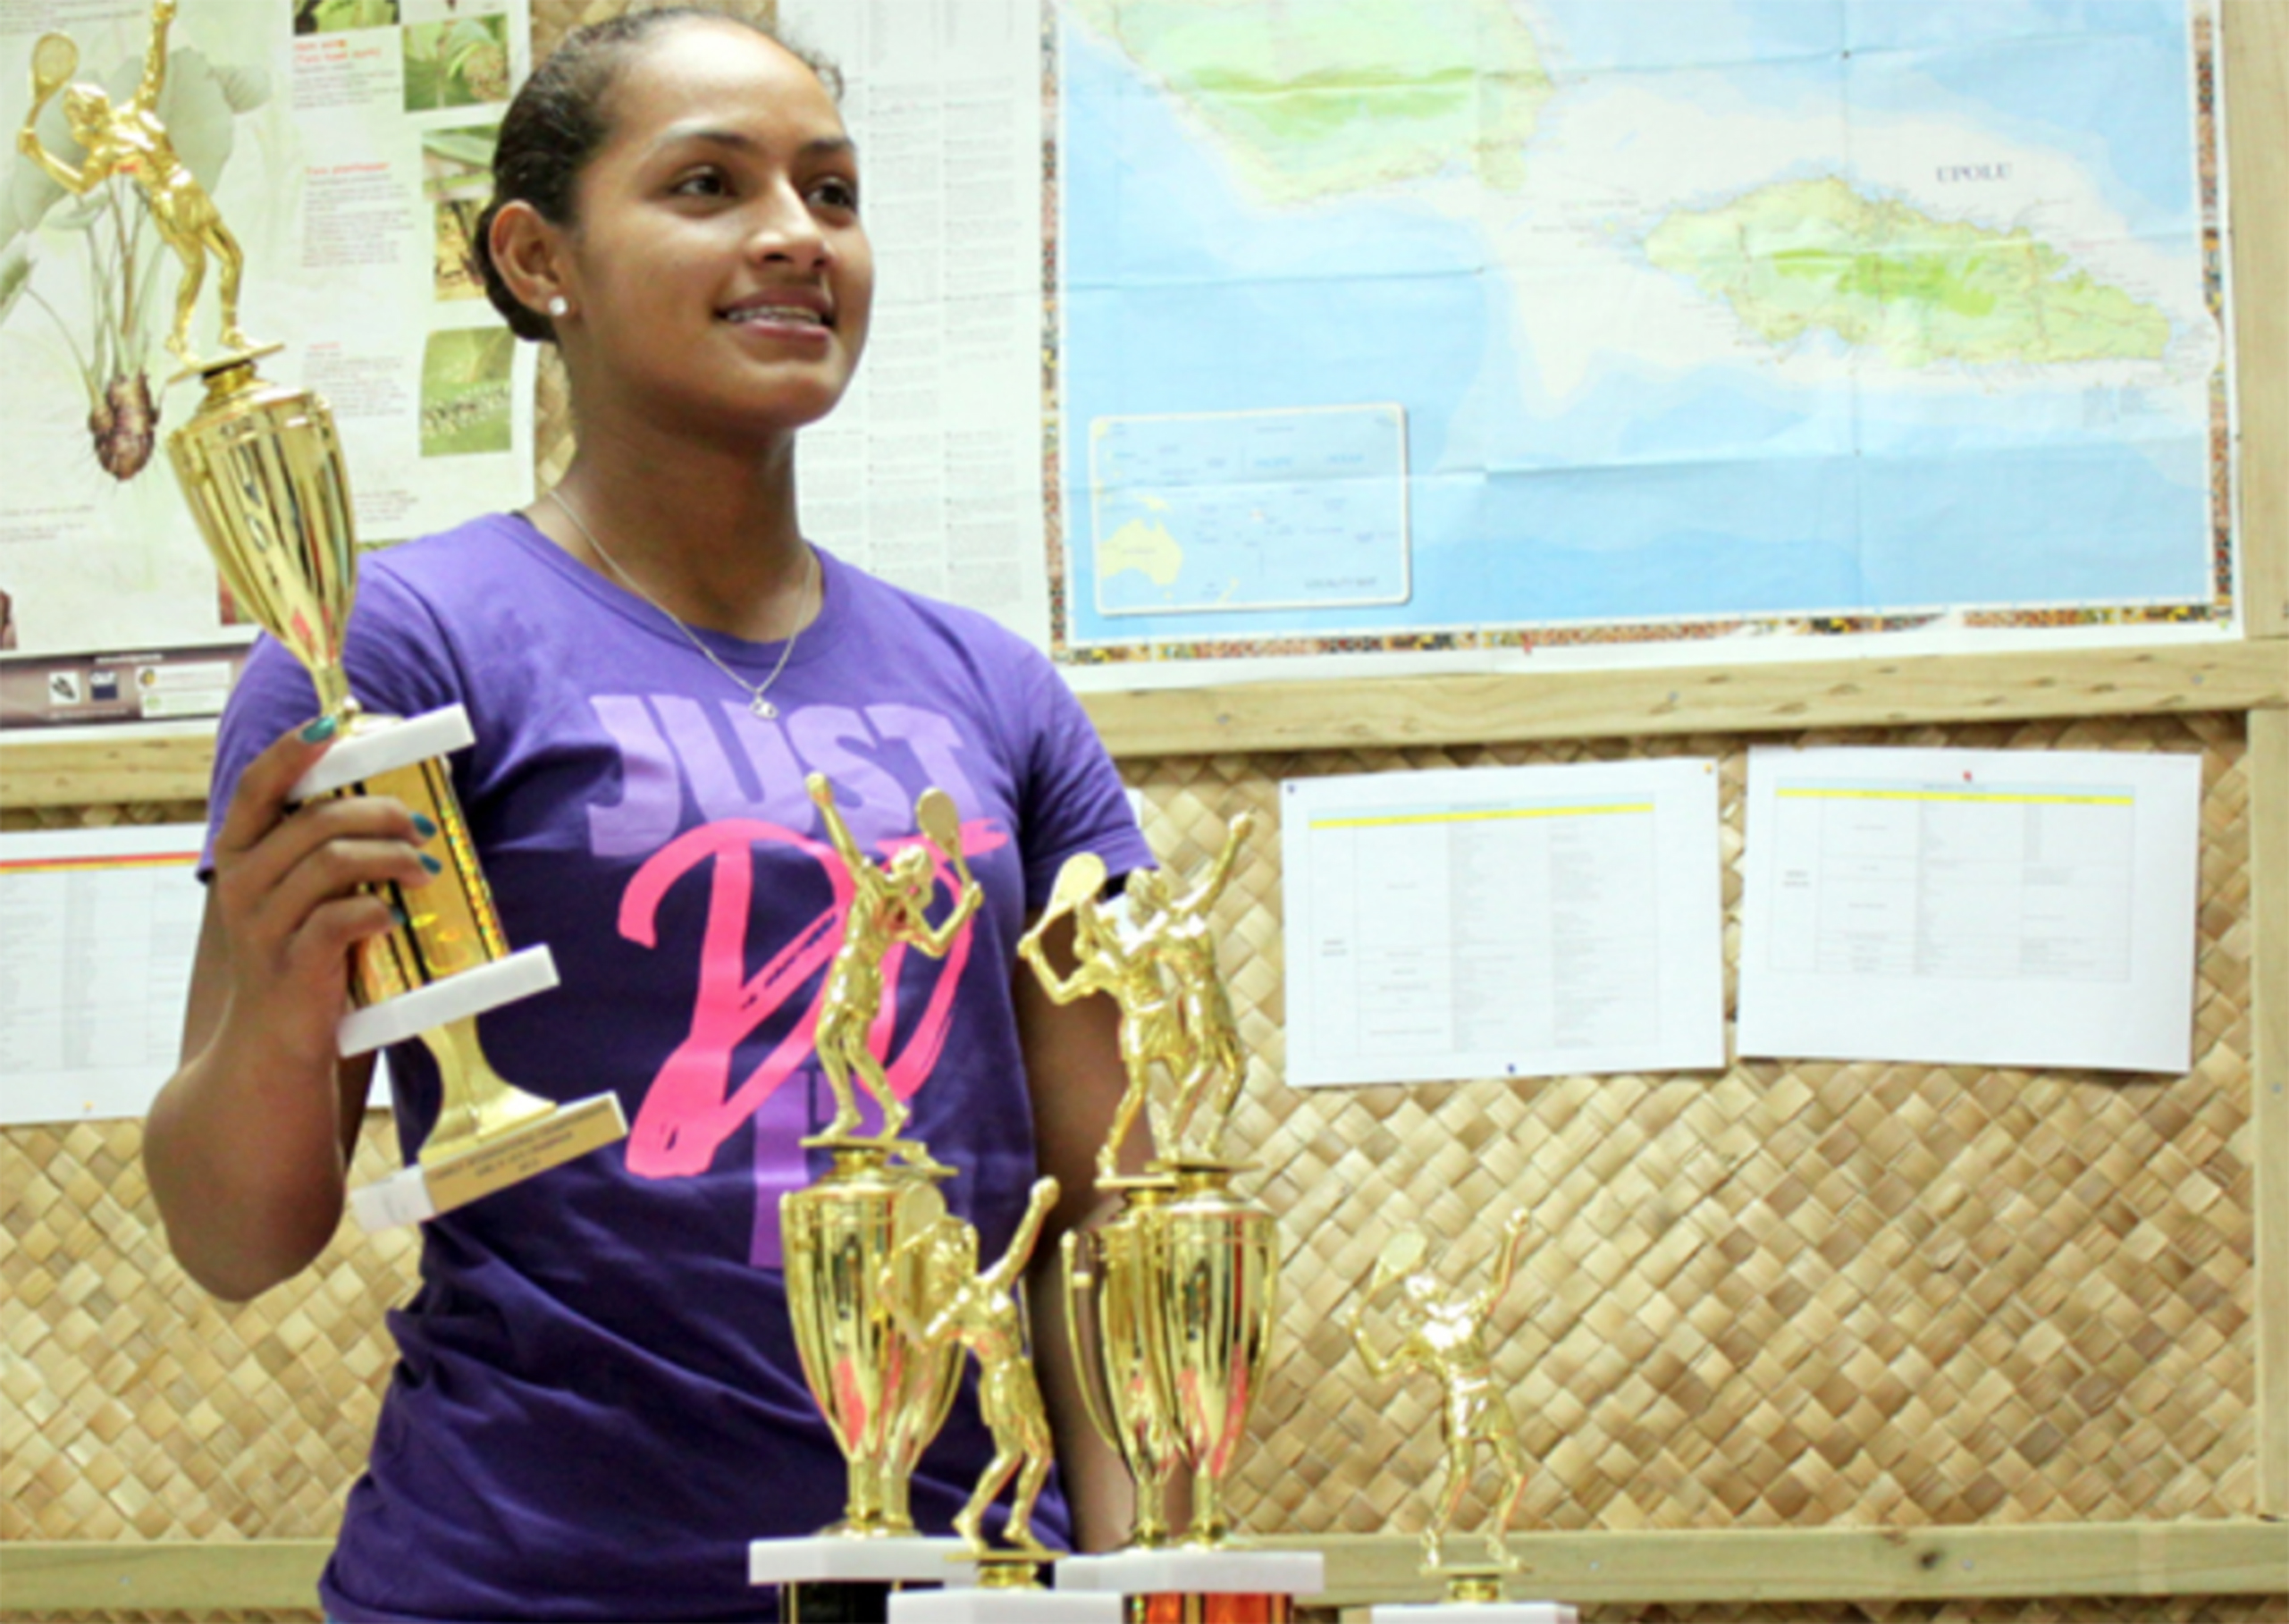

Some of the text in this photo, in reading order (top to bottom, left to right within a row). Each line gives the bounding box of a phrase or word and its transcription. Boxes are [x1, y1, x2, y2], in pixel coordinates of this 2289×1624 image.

[1936, 162, 2012, 183] UPOLU
[588, 694, 994, 856] JUST
[617, 818, 1007, 1177] DO
